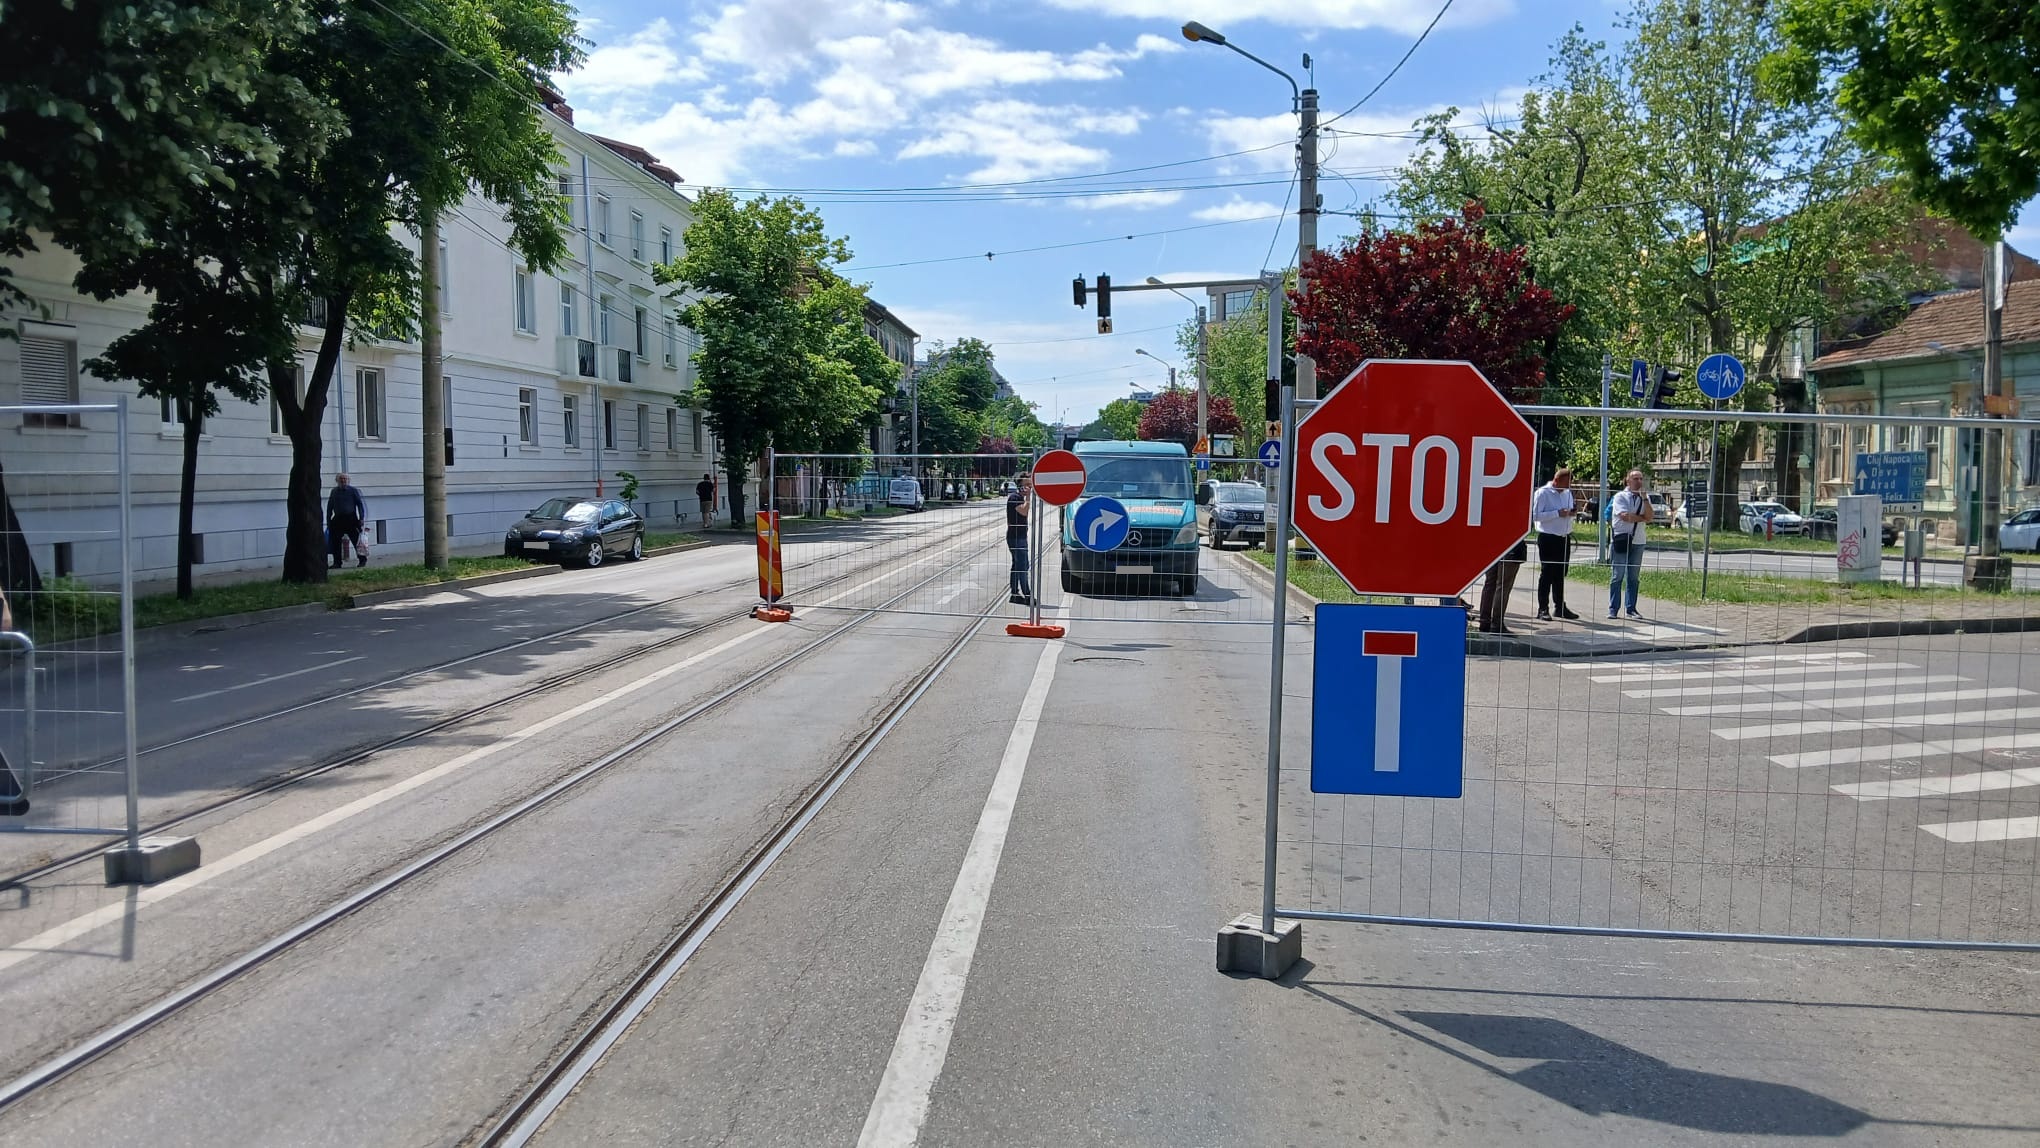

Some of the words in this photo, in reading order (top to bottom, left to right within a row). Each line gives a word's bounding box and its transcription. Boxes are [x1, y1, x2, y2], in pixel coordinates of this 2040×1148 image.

[1872, 467, 1898, 477] Deva
[1308, 432, 1520, 526] STOP
[1871, 480, 1896, 490] Arad
[1882, 504, 1905, 513] ntru
